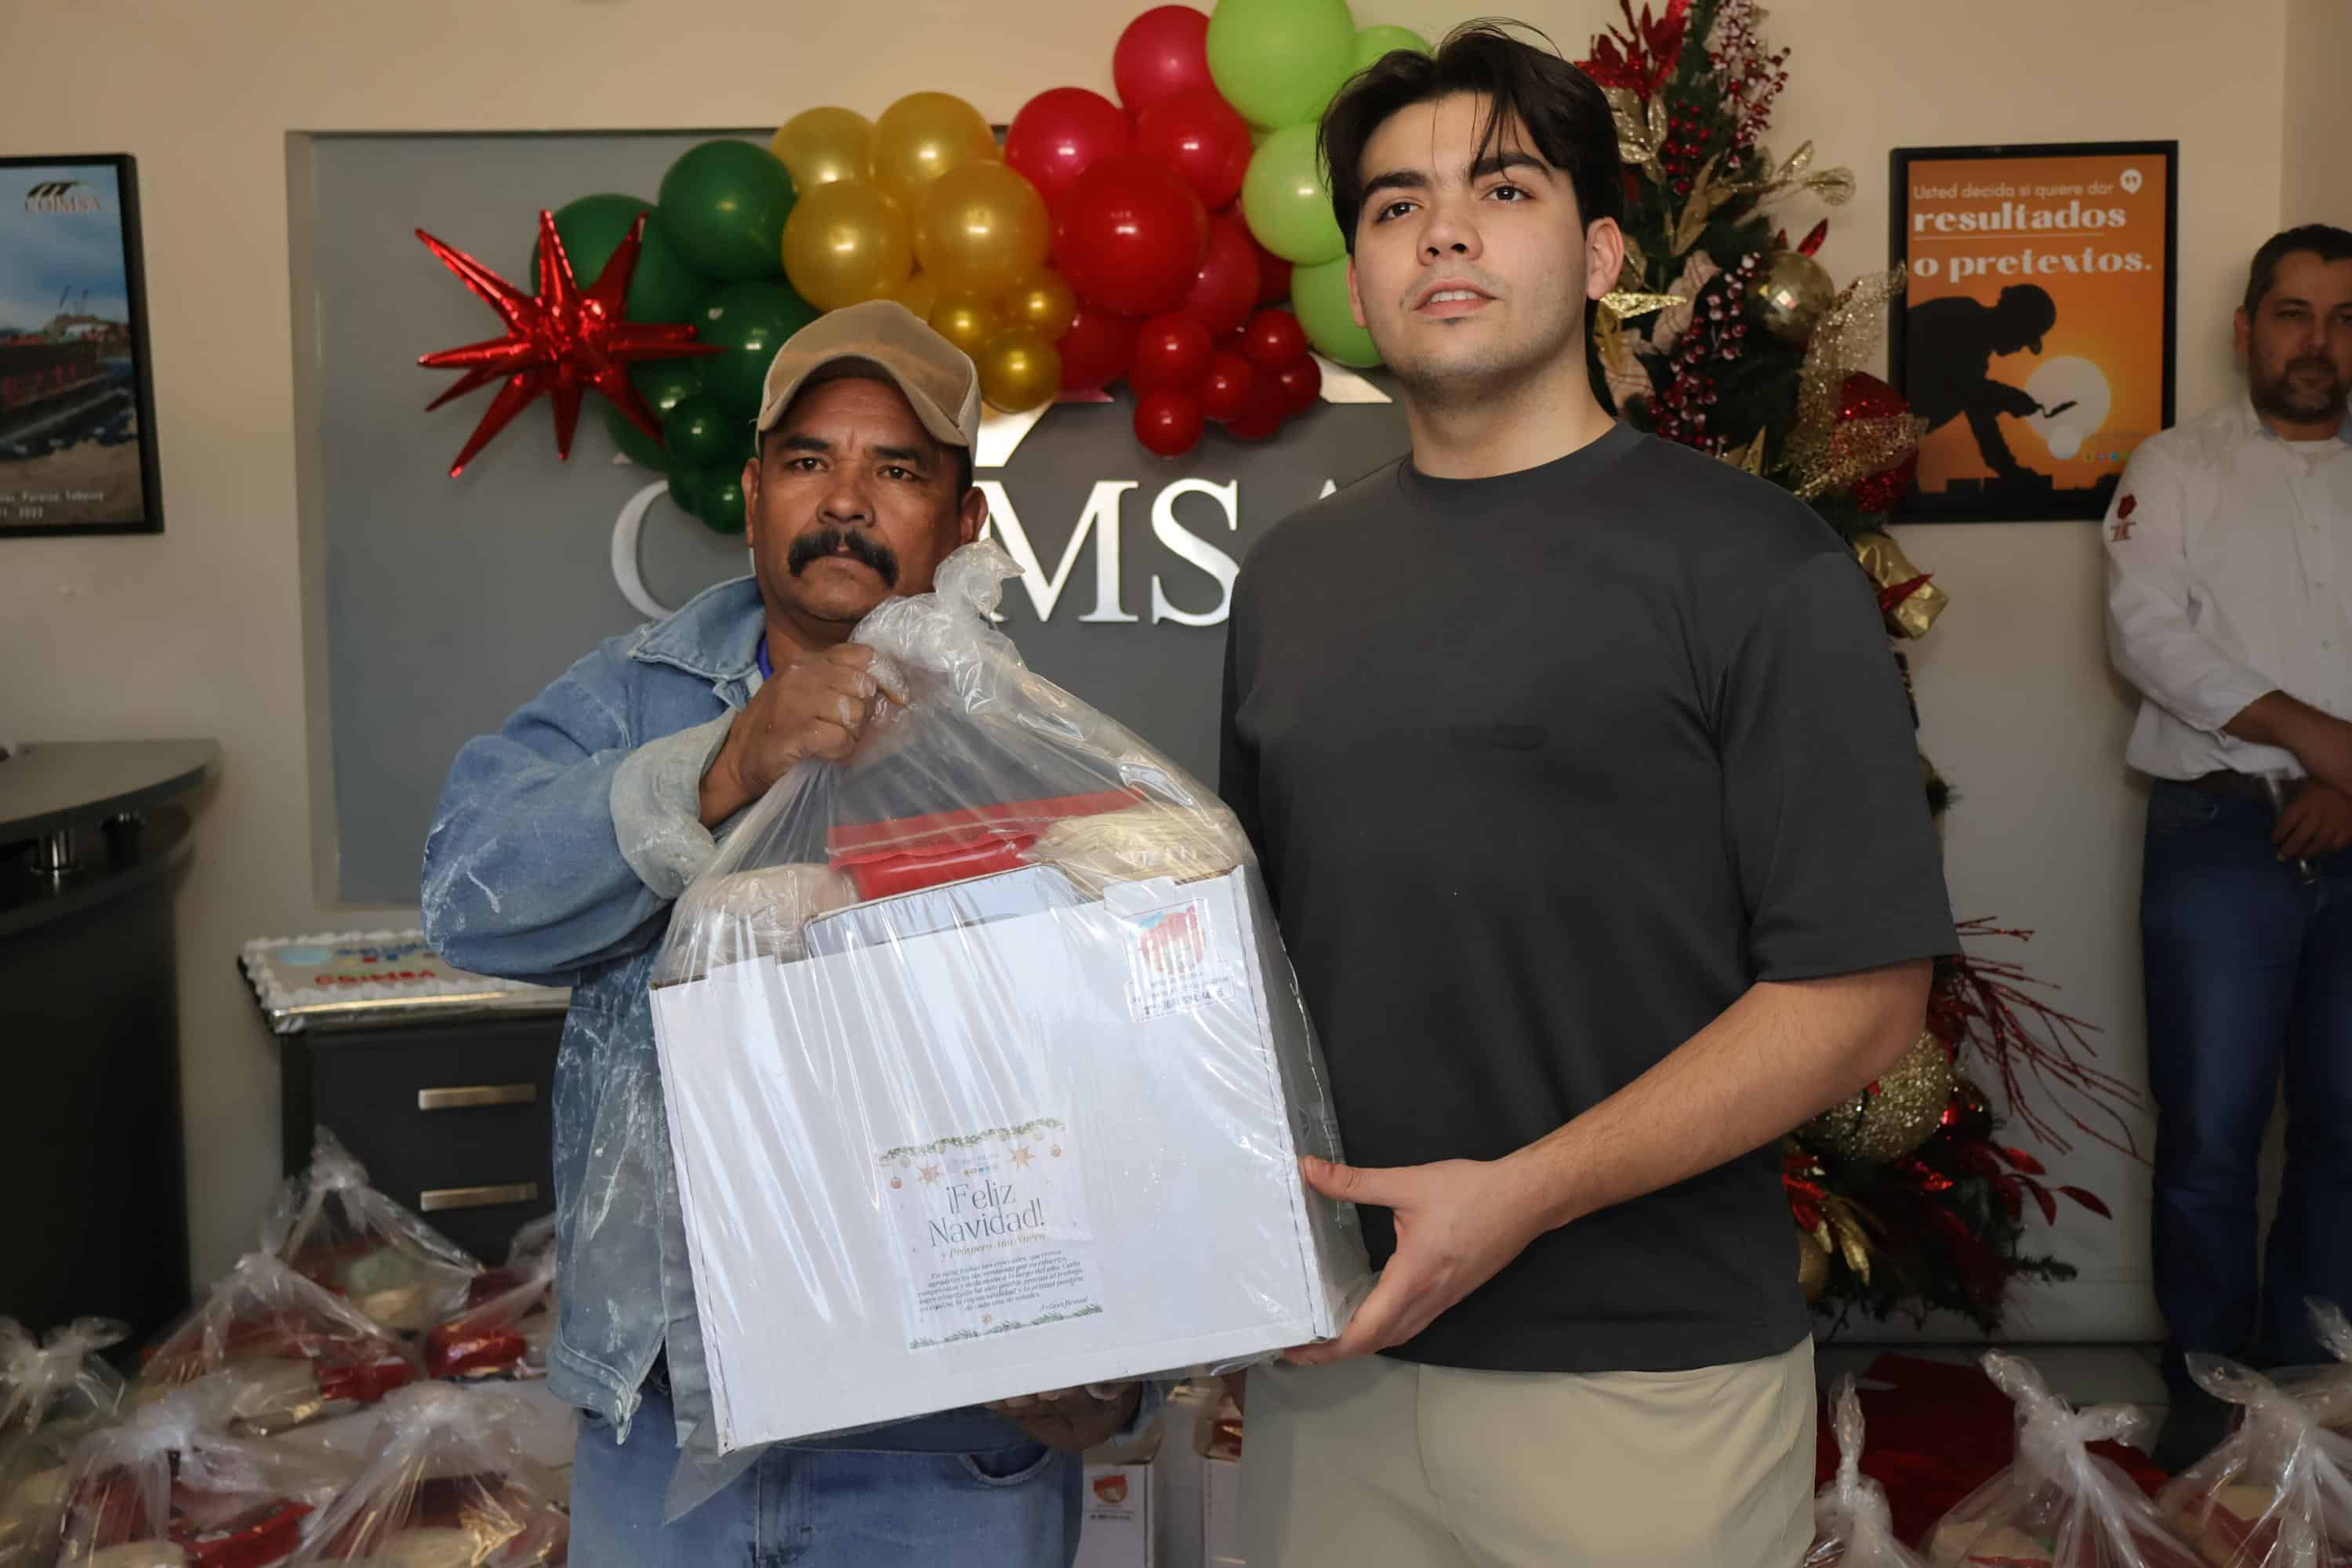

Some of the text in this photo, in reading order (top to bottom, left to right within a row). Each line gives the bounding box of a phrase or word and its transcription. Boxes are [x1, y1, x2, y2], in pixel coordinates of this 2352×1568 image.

[1913, 180, 2114, 201] Usted decide si quiere dar
[1913, 201, 2127, 233] resultados
[1913, 247, 2153, 283] o pretextos.
[946, 1179, 1017, 1214] ¡Feliz
[928, 1198, 1046, 1247] Navidad!
